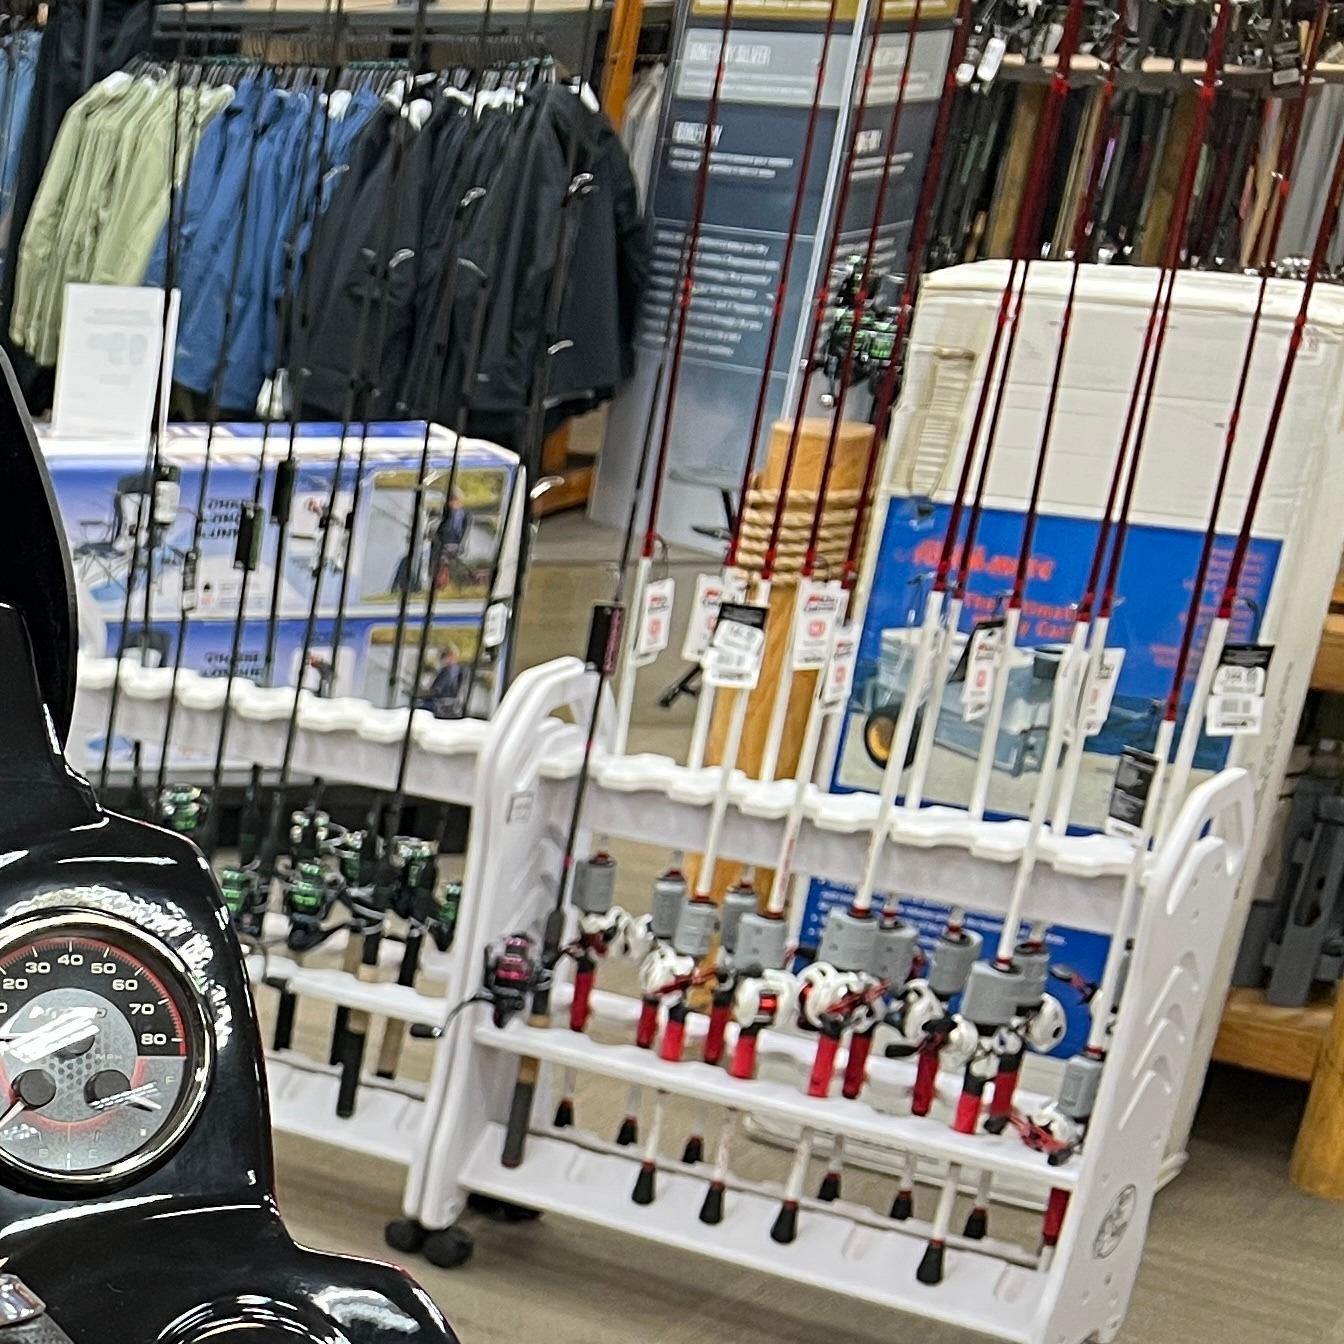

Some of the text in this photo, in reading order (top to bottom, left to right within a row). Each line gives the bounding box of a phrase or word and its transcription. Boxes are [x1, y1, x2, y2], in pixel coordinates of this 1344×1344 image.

[57, 955, 83, 966] 40
[25, 962, 51, 973] 30
[91, 963, 116, 974] 50
[2, 979, 28, 990] 20
[112, 979, 138, 991] 60
[129, 1004, 155, 1015] 70
[141, 1034, 166, 1045] 80
